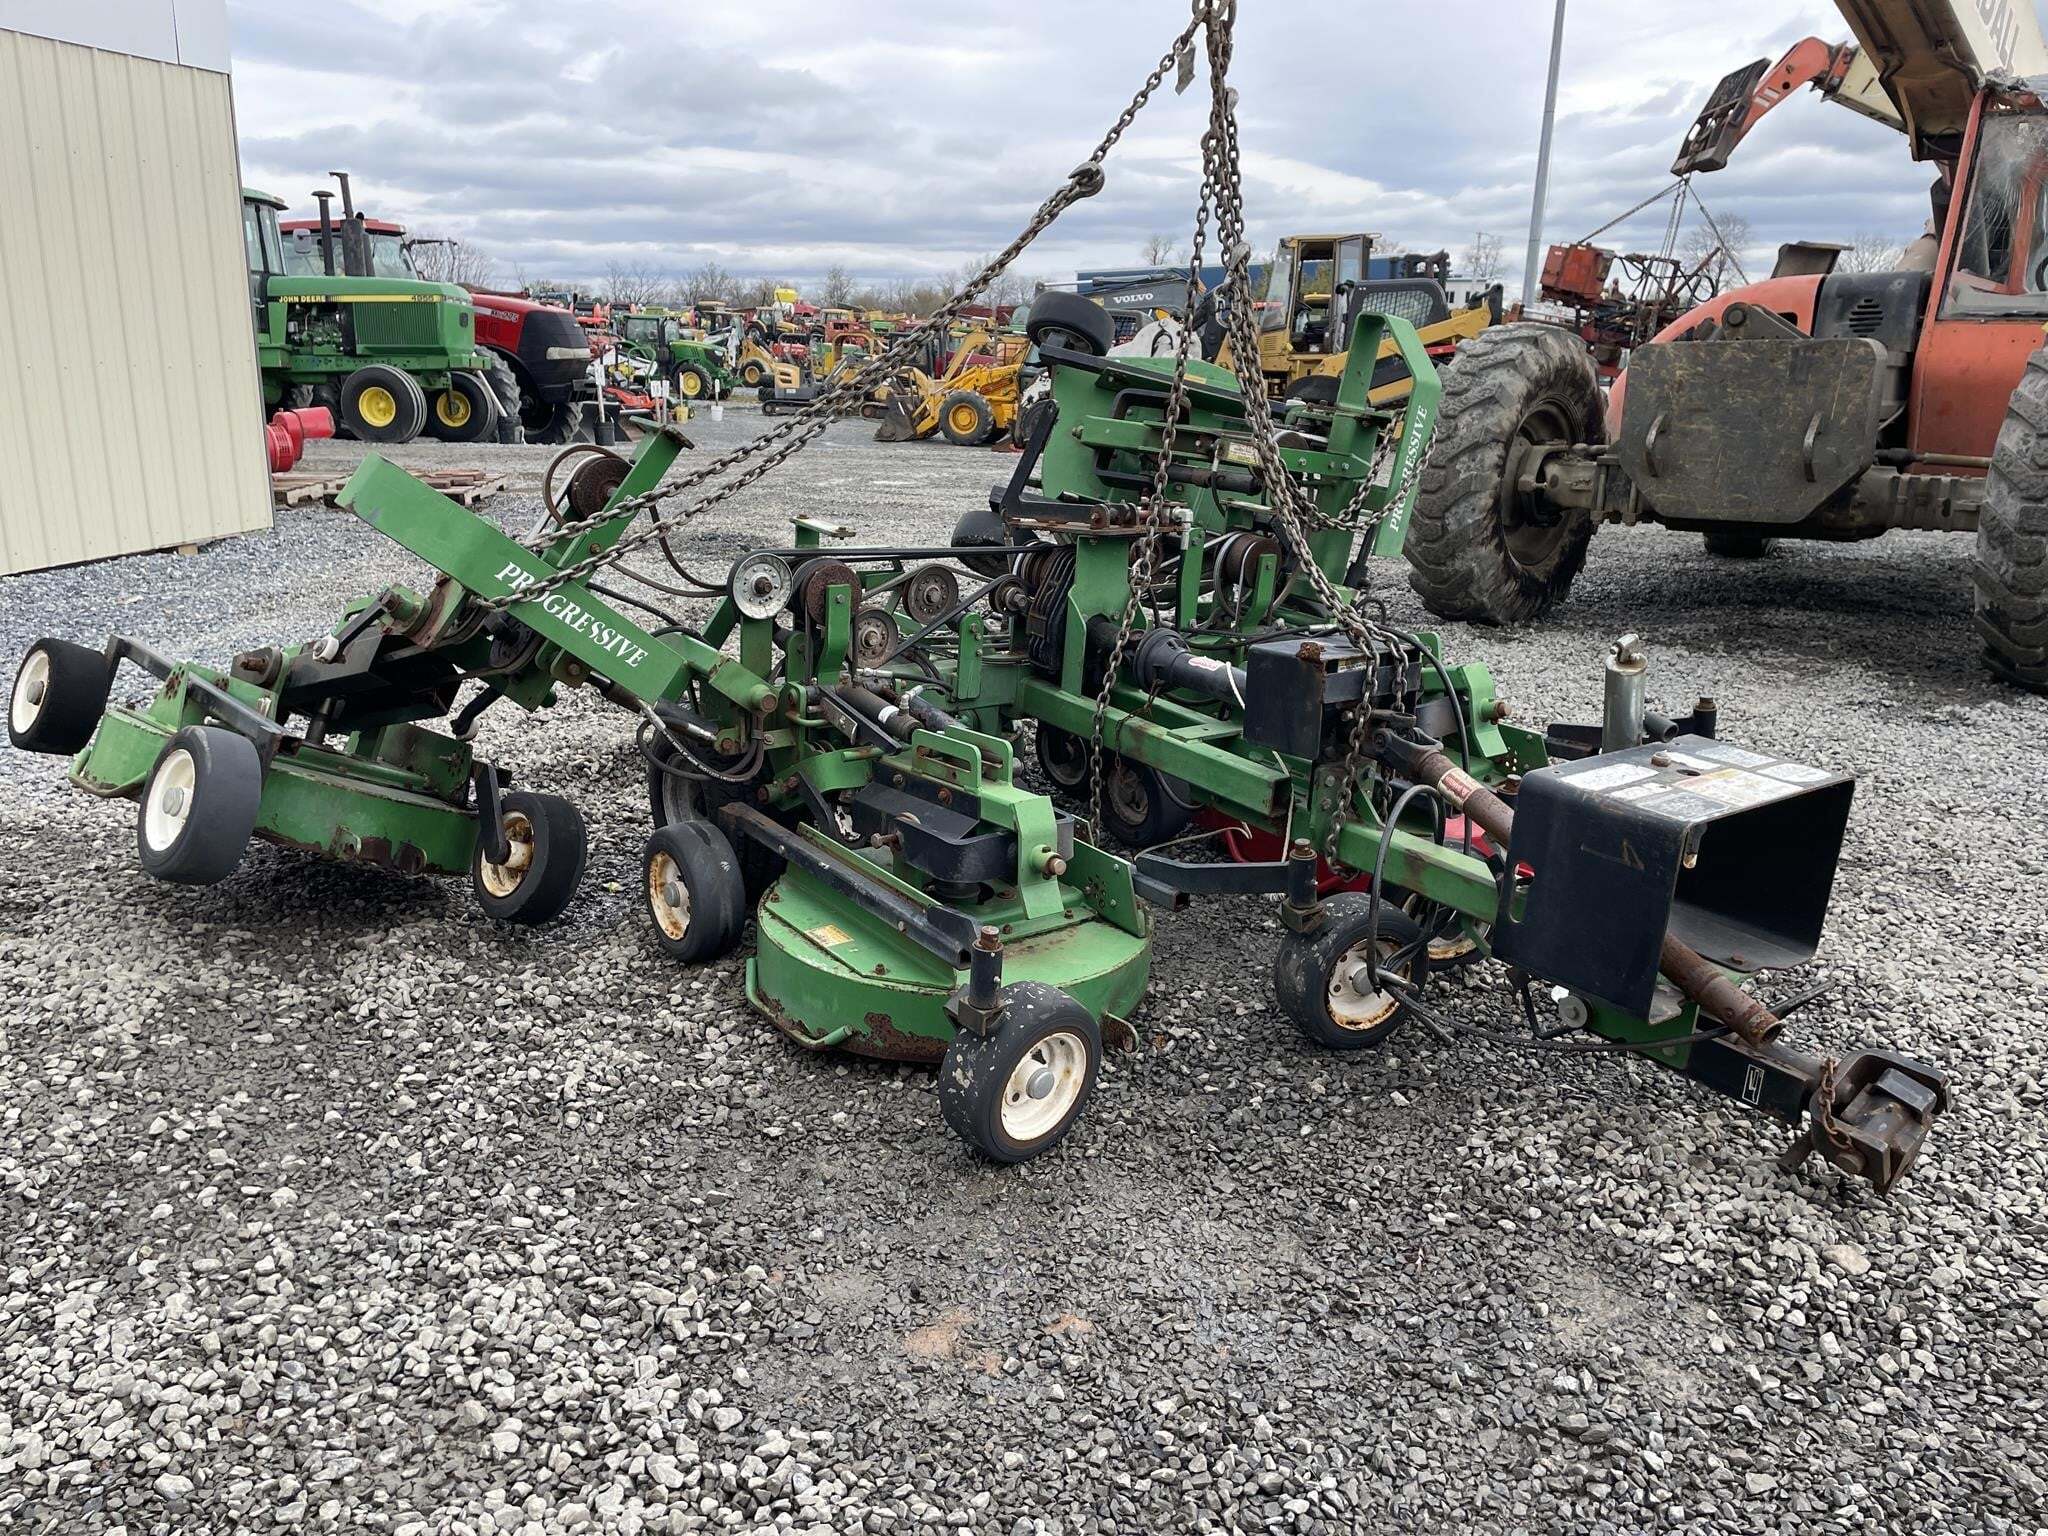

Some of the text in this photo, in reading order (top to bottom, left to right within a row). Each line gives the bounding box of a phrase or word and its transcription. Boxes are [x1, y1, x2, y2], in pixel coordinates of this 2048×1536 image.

[278, 295, 326, 303] JOHN DEERE
[1113, 292, 1154, 304] VOLVO
[1390, 405, 1428, 533] PRRESSIVE
